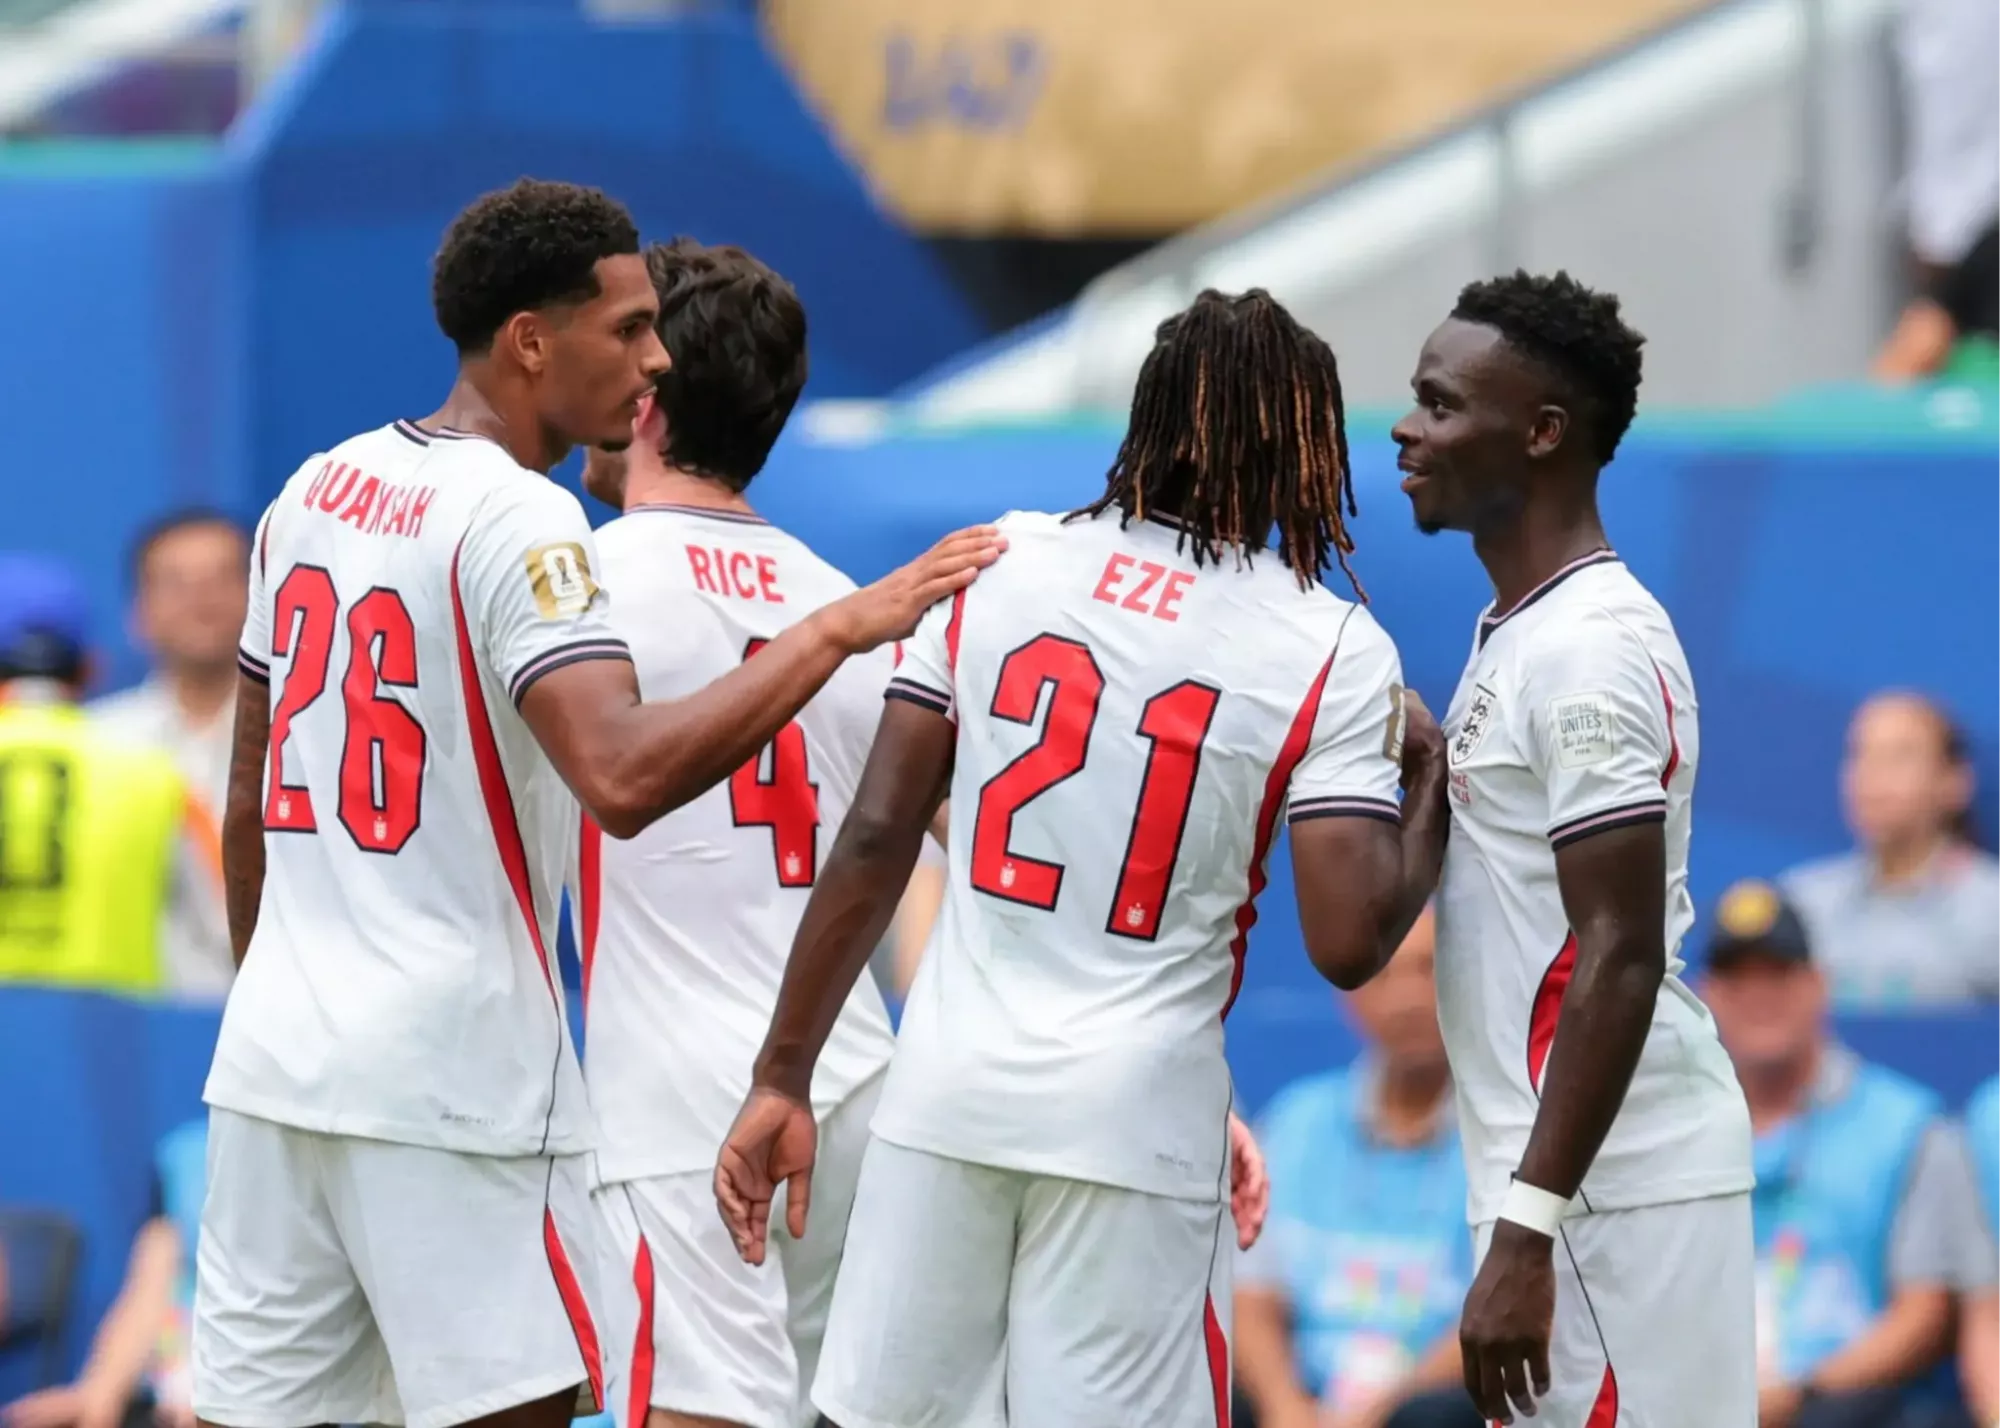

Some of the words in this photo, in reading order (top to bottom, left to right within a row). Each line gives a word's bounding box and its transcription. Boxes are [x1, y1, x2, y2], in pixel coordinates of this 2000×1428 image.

[685, 544, 785, 604] RICE
[1092, 552, 1197, 623] EZE
[264, 562, 427, 856] 26
[729, 637, 820, 888] 4
[971, 632, 1222, 942] 21
[1560, 713, 1602, 734] UNITES
